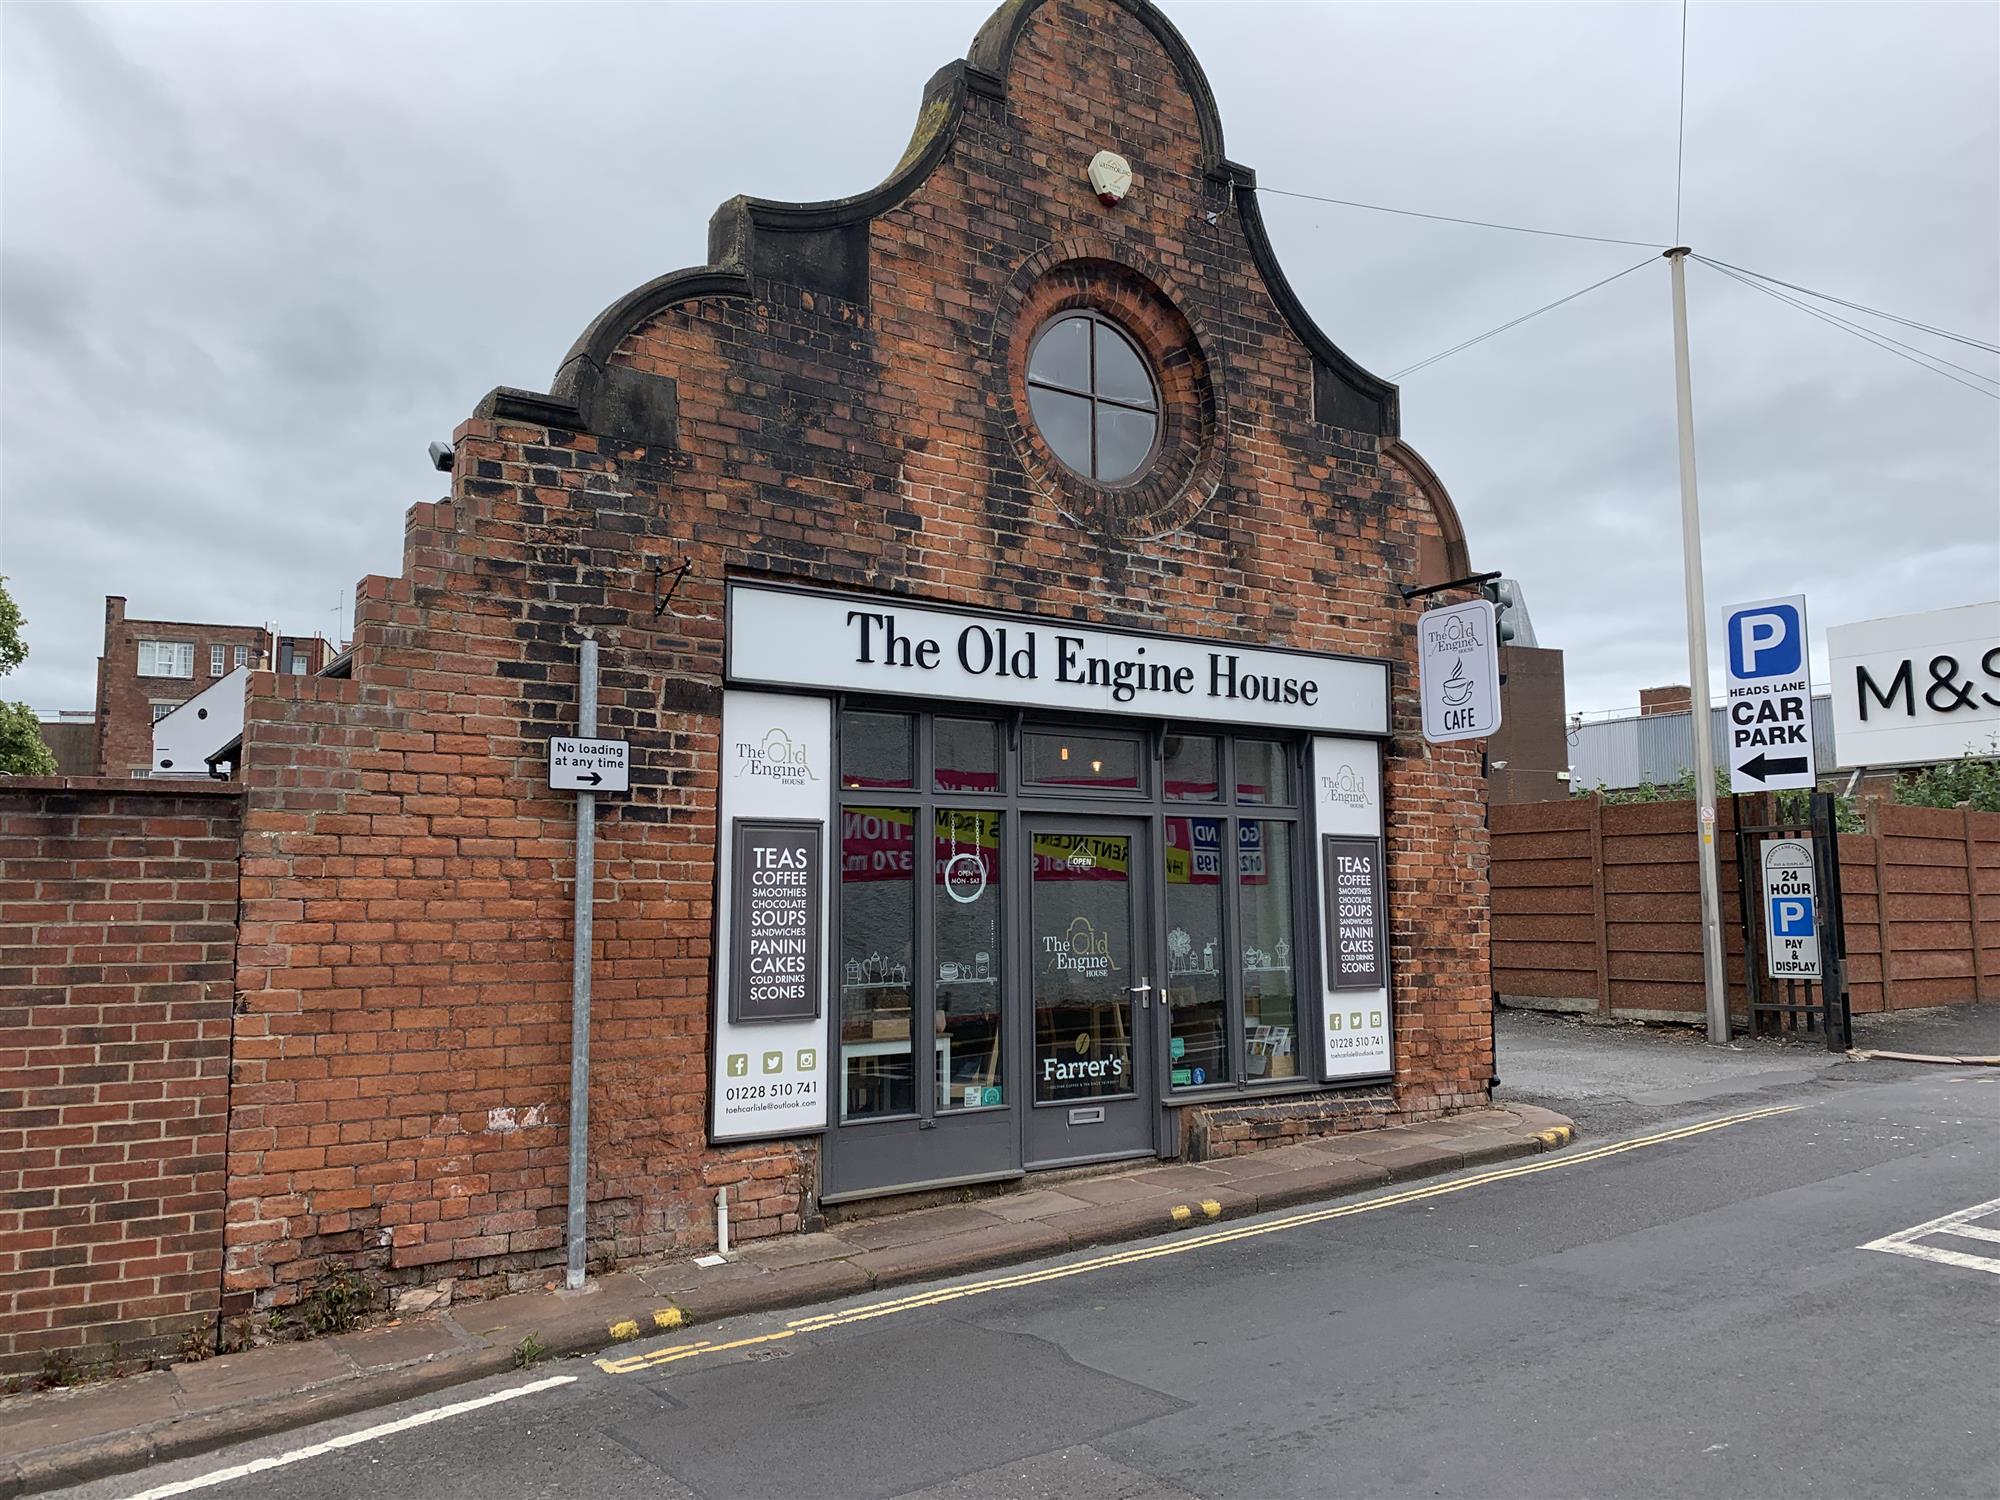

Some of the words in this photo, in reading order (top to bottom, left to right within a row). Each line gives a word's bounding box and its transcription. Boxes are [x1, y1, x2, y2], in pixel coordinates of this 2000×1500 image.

[1428, 632, 1447, 642] The
[1448, 622, 1474, 640] Old
[1438, 638, 1474, 652] Engine
[1740, 613, 1786, 673] P
[847, 611, 941, 669] The
[957, 625, 1038, 679] Old
[1054, 635, 1194, 702] Engine
[1207, 653, 1318, 706] House
[1730, 685, 1770, 697] HEADS
[1774, 681, 1806, 693] LANE
[1444, 708, 1475, 730] CAFE
[1732, 697, 1804, 726] CAR
[1734, 724, 1807, 748] PARK
[557, 742, 575, 753] No
[579, 744, 623, 757] loading
[736, 743, 765, 759] The
[768, 742, 808, 764] Old
[555, 756, 567, 766] at
[572, 758, 593, 769] any
[598, 758, 624, 768] time
[750, 760, 805, 780] Engine
[1321, 776, 1339, 789] The
[1340, 775, 1365, 792] Old
[1331, 789, 1365, 804] Engine
[753, 848, 807, 869] TEAS
[1073, 858, 1091, 866] OPEN
[1337, 857, 1371, 873] TEAS
[752, 872, 807, 885] COFFEE
[1338, 875, 1371, 886] COFFEE
[1782, 870, 1798, 881] 24
[752, 888, 807, 897] SMOOTHIES
[1771, 883, 1811, 895] HOUR
[752, 900, 806, 909] CHOCOLATE
[1338, 896, 1372, 904] CHOCOLATE
[752, 910, 806, 926] SOUPS
[1340, 905, 1372, 917] SOUPS
[1780, 902, 1804, 932] P
[752, 928, 806, 937] SANDWICHES
[1340, 927, 1373, 939] PANINI
[750, 939, 806, 955] PANINI
[1043, 936, 1071, 952] The
[1072, 932, 1109, 955] Old
[1341, 940, 1374, 953] CAKES
[1785, 939, 1803, 949] PAY
[1056, 952, 1108, 972] Engine
[1792, 951, 1799, 960] &
[750, 956, 806, 973] CAKES
[1342, 962, 1375, 973] SCONES
[1776, 962, 1816, 972] DISPLAY
[750, 976, 773, 985] COLD
[776, 974, 806, 984] DRINKS
[1086, 970, 1108, 978] HOUSE
[750, 985, 806, 1000] SCONES
[1330, 1038, 1353, 1049] 01228
[1356, 1036, 1369, 1047] 510
[1371, 1036, 1384, 1045] 741
[1043, 1054, 1122, 1081] Farrer's
[726, 1085, 765, 1101] 01228
[770, 1083, 793, 1097] 510
[797, 1081, 817, 1095] 741
[726, 1100, 817, 1114] toehcarlisle@outlook.com
